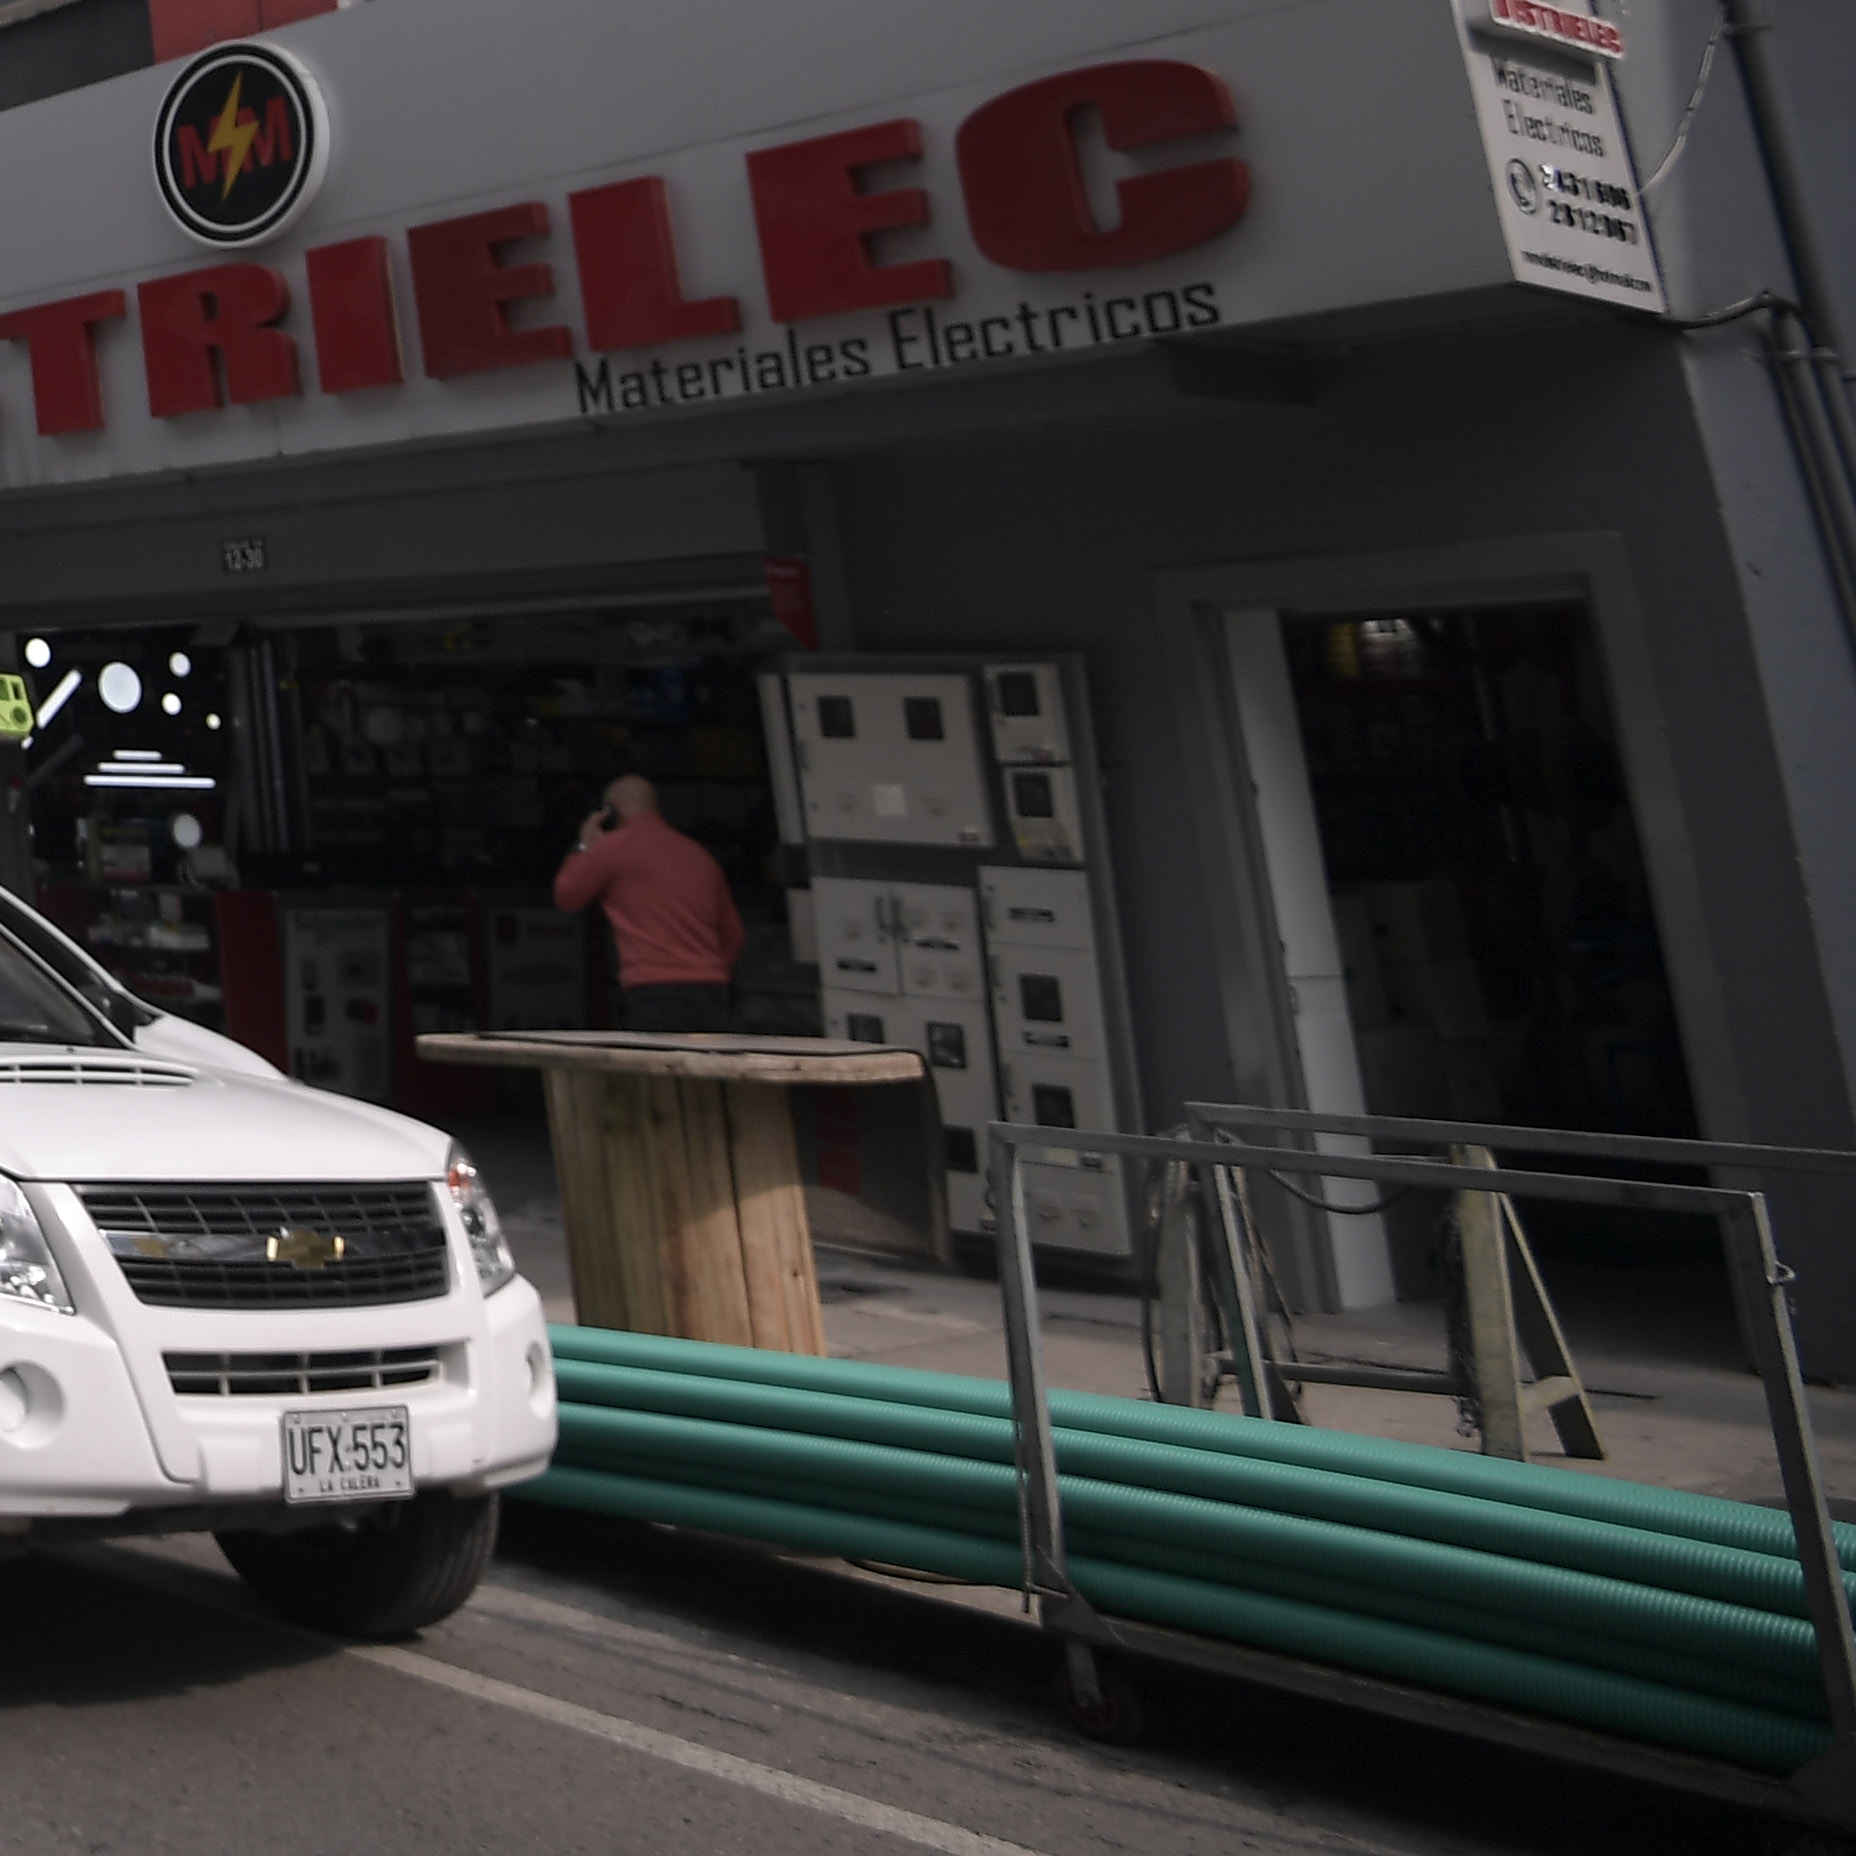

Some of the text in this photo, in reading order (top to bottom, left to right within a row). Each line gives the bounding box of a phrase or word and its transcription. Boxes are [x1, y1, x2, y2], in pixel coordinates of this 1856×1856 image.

[1492, 57, 1593, 114] Materiales
[574, 280, 1221, 414] Materiales Electricos
